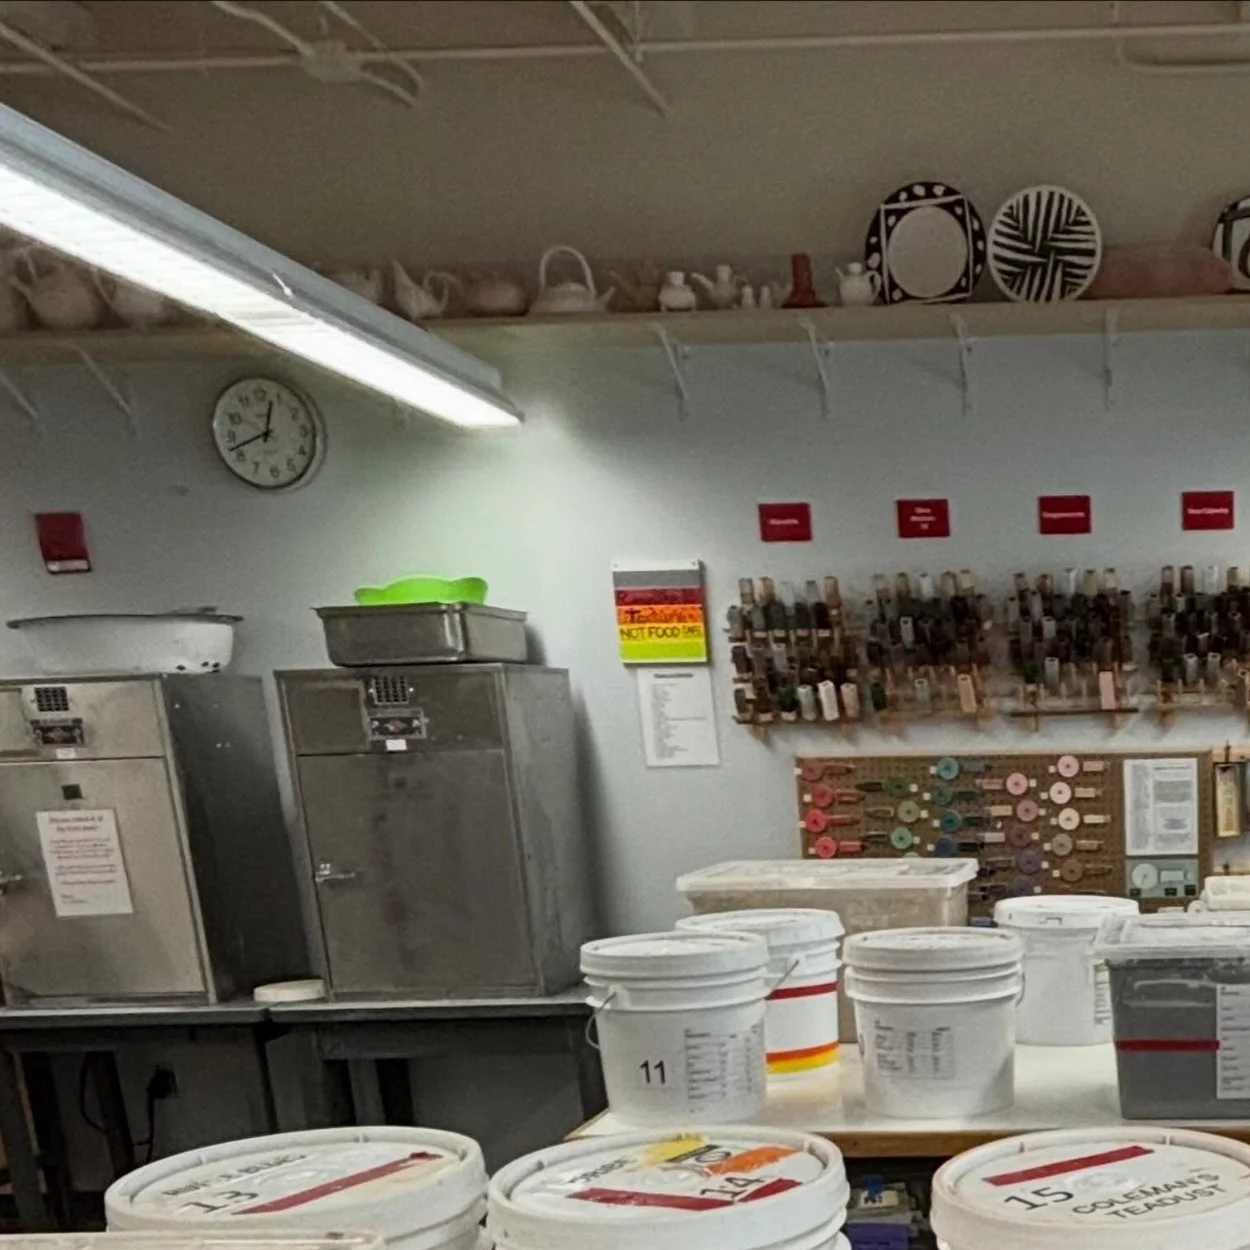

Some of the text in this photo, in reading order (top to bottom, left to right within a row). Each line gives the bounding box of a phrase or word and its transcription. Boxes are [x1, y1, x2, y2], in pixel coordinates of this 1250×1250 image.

[620, 627, 645, 640] NOT
[647, 626, 680, 639] FOOD
[639, 1060, 666, 1085] 11
[700, 1177, 766, 1198] 14
[1004, 1187, 1074, 1210] 15
[1072, 1173, 1220, 1215] COLEMAN'S
[1107, 1184, 1227, 1219] TEADUST
